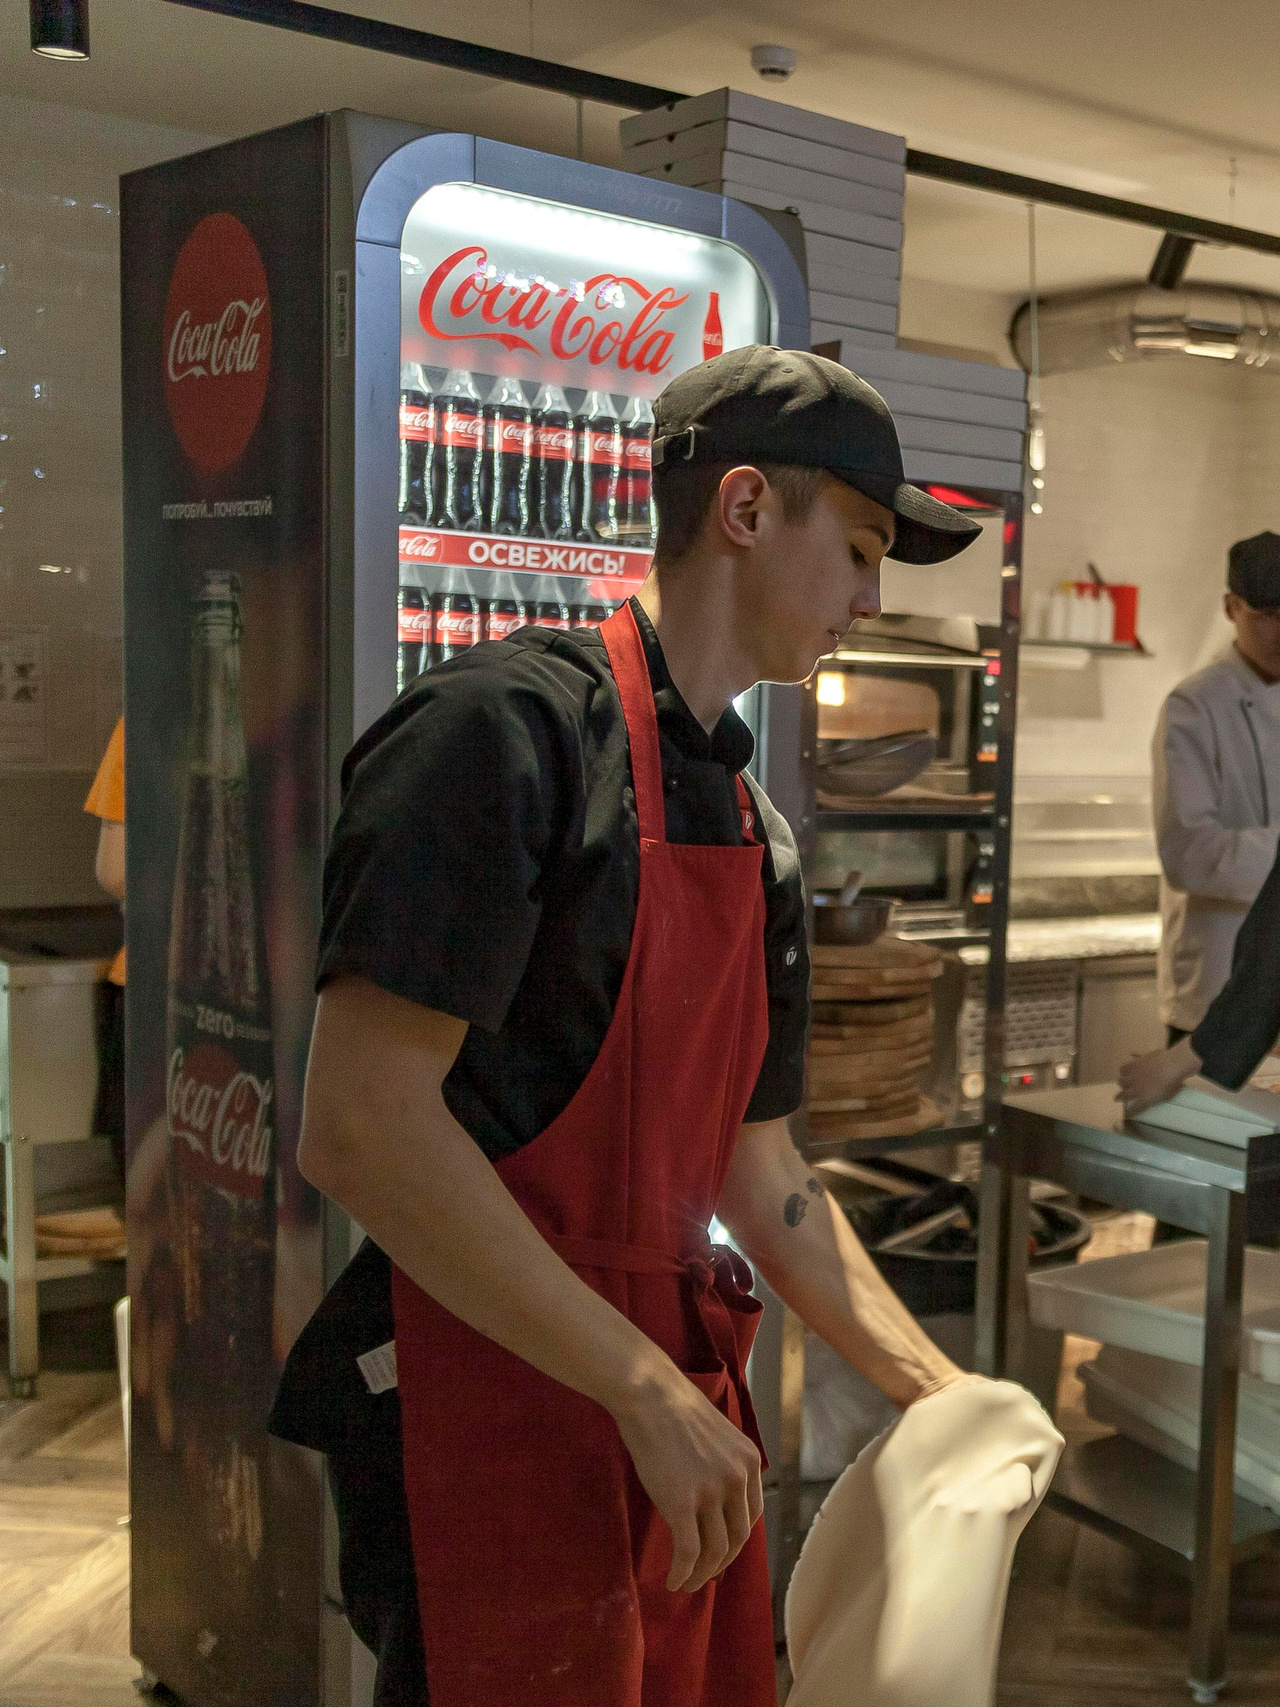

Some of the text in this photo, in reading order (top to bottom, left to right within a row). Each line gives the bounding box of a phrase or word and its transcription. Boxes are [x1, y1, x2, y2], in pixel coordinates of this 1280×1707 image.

[167, 297, 266, 382] Coca-Cola
[418, 246, 690, 376] Coca-Cola
[468, 540, 626, 576] ОСВЕЖИСЬ!
[196, 1005, 233, 1040] zero
[166, 1047, 273, 1177] Coca-Cola
